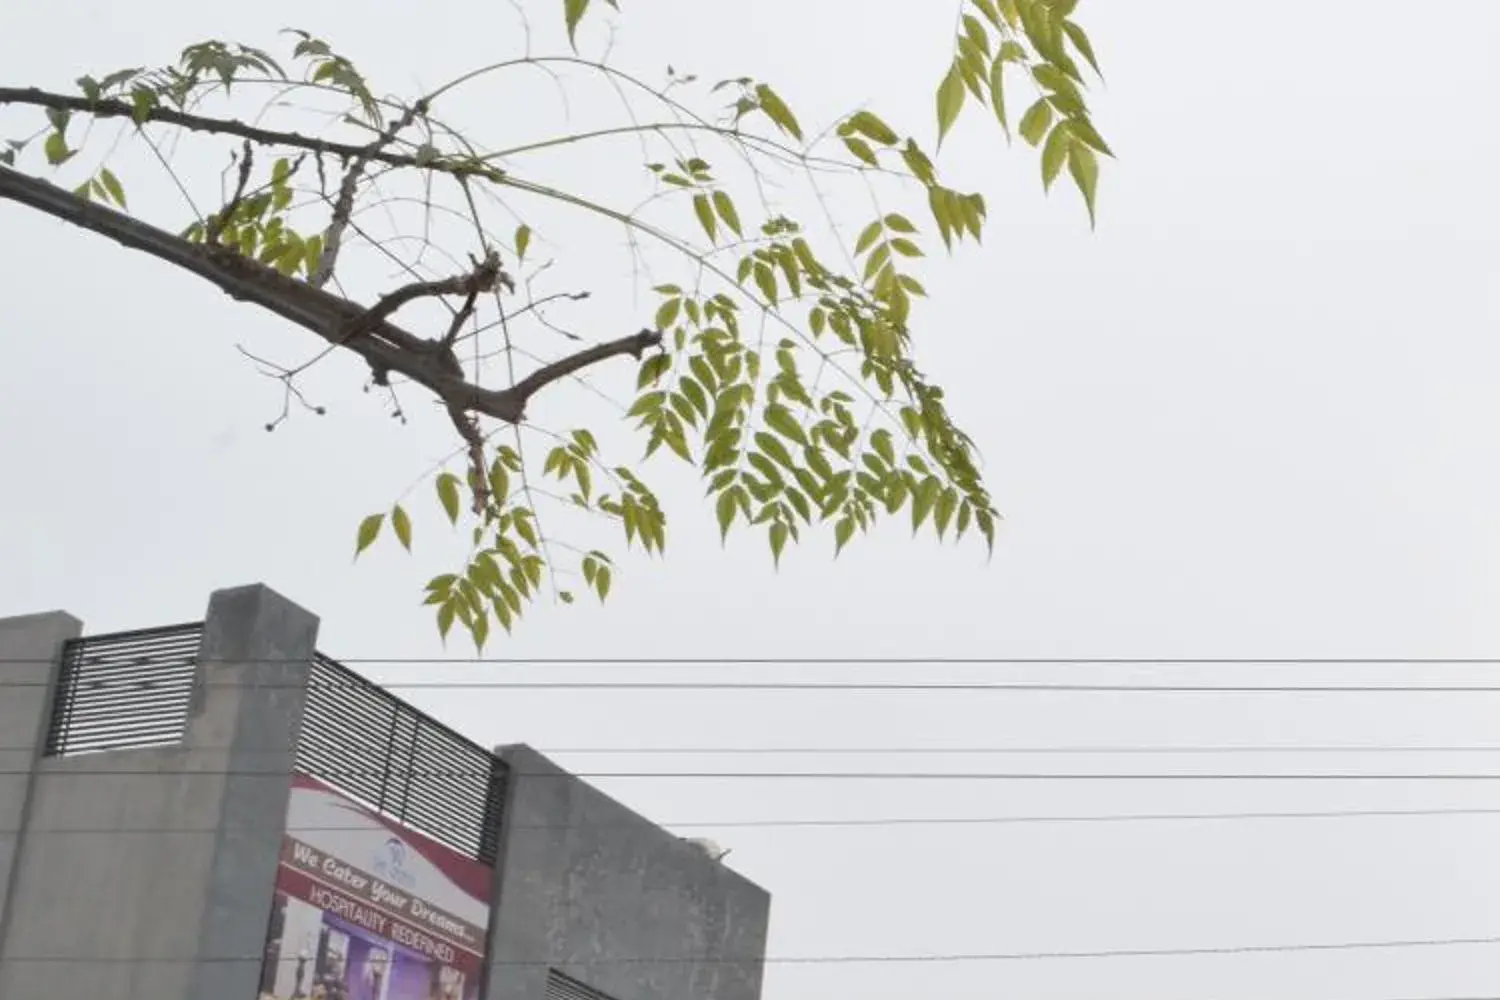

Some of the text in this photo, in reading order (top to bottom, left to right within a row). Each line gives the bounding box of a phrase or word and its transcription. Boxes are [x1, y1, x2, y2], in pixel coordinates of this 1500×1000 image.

[294, 842, 320, 867] We
[323, 857, 369, 889] Cater
[370, 880, 408, 908] Your
[310, 884, 456, 964] HOSPITALITY REDEFINED
